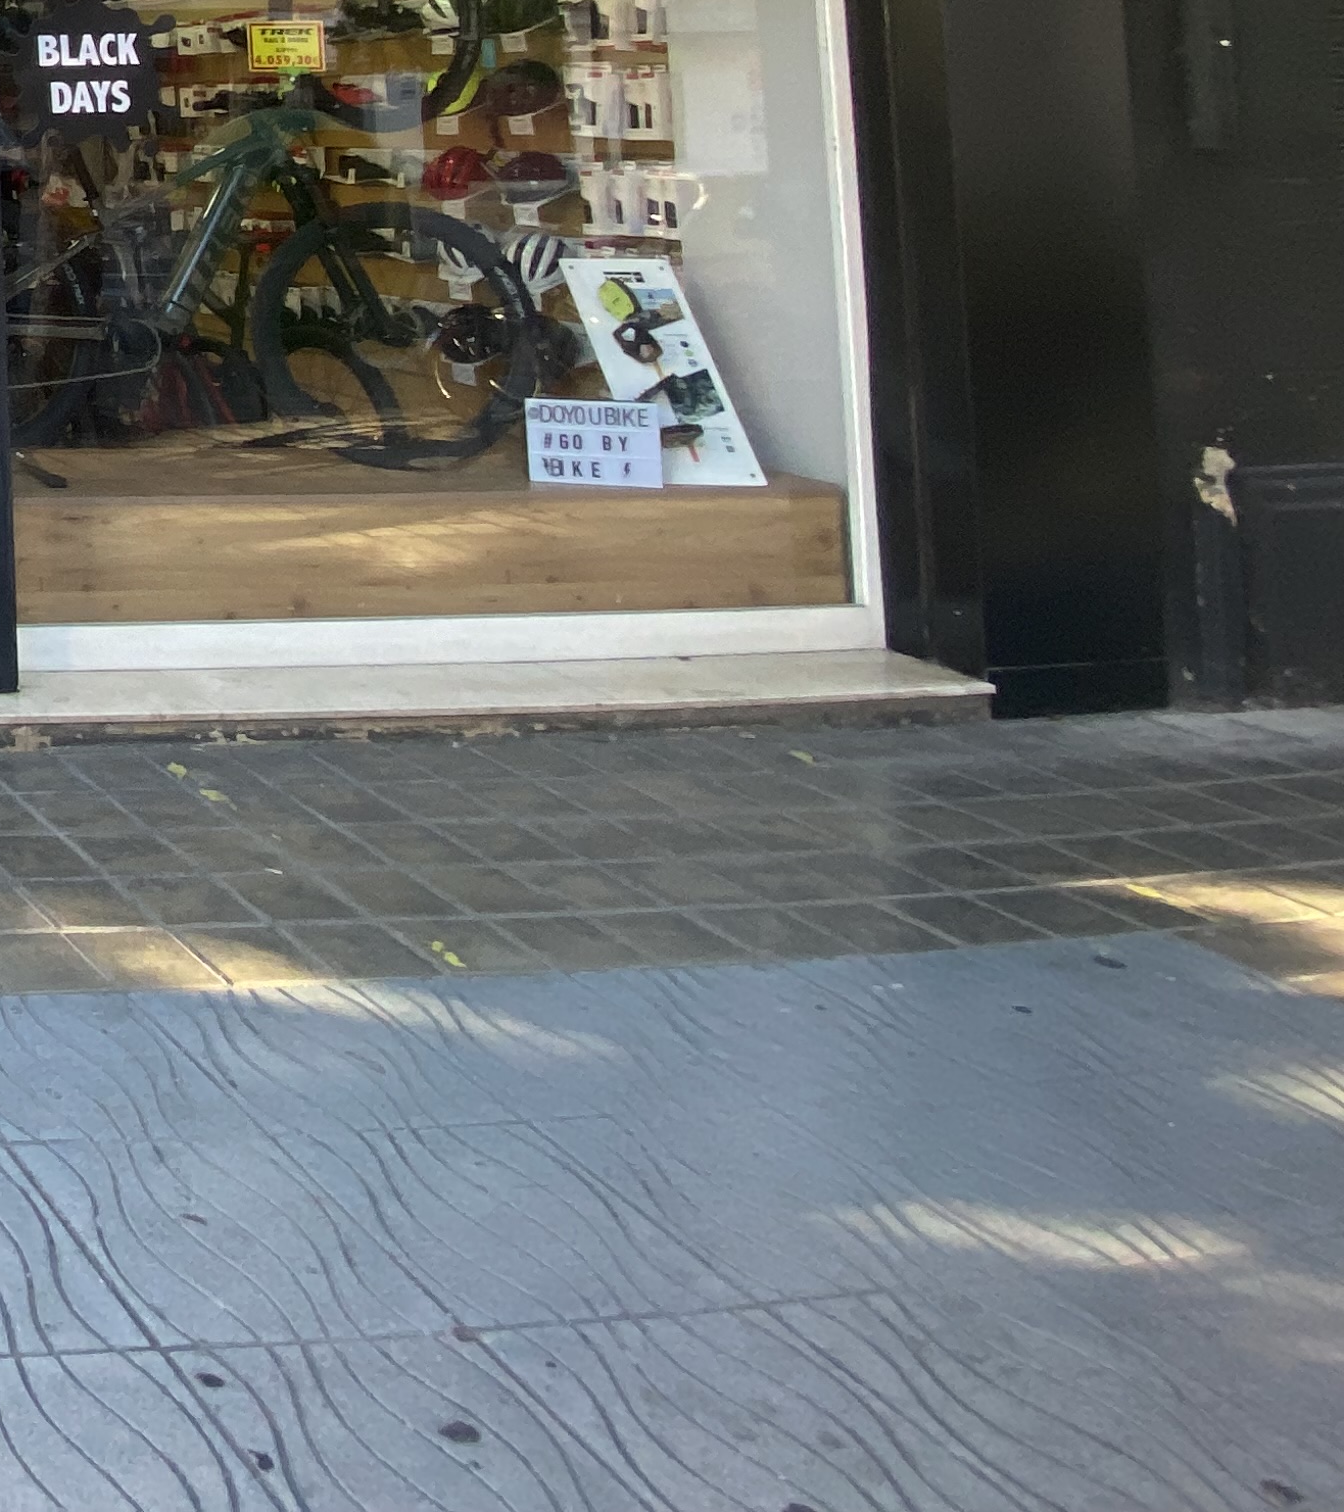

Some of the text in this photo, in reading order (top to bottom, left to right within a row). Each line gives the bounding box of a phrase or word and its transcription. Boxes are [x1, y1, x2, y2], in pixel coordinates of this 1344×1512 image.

[37, 33, 140, 68] BLACK
[50, 80, 131, 114] DAYS
[602, 435, 628, 452] BY
